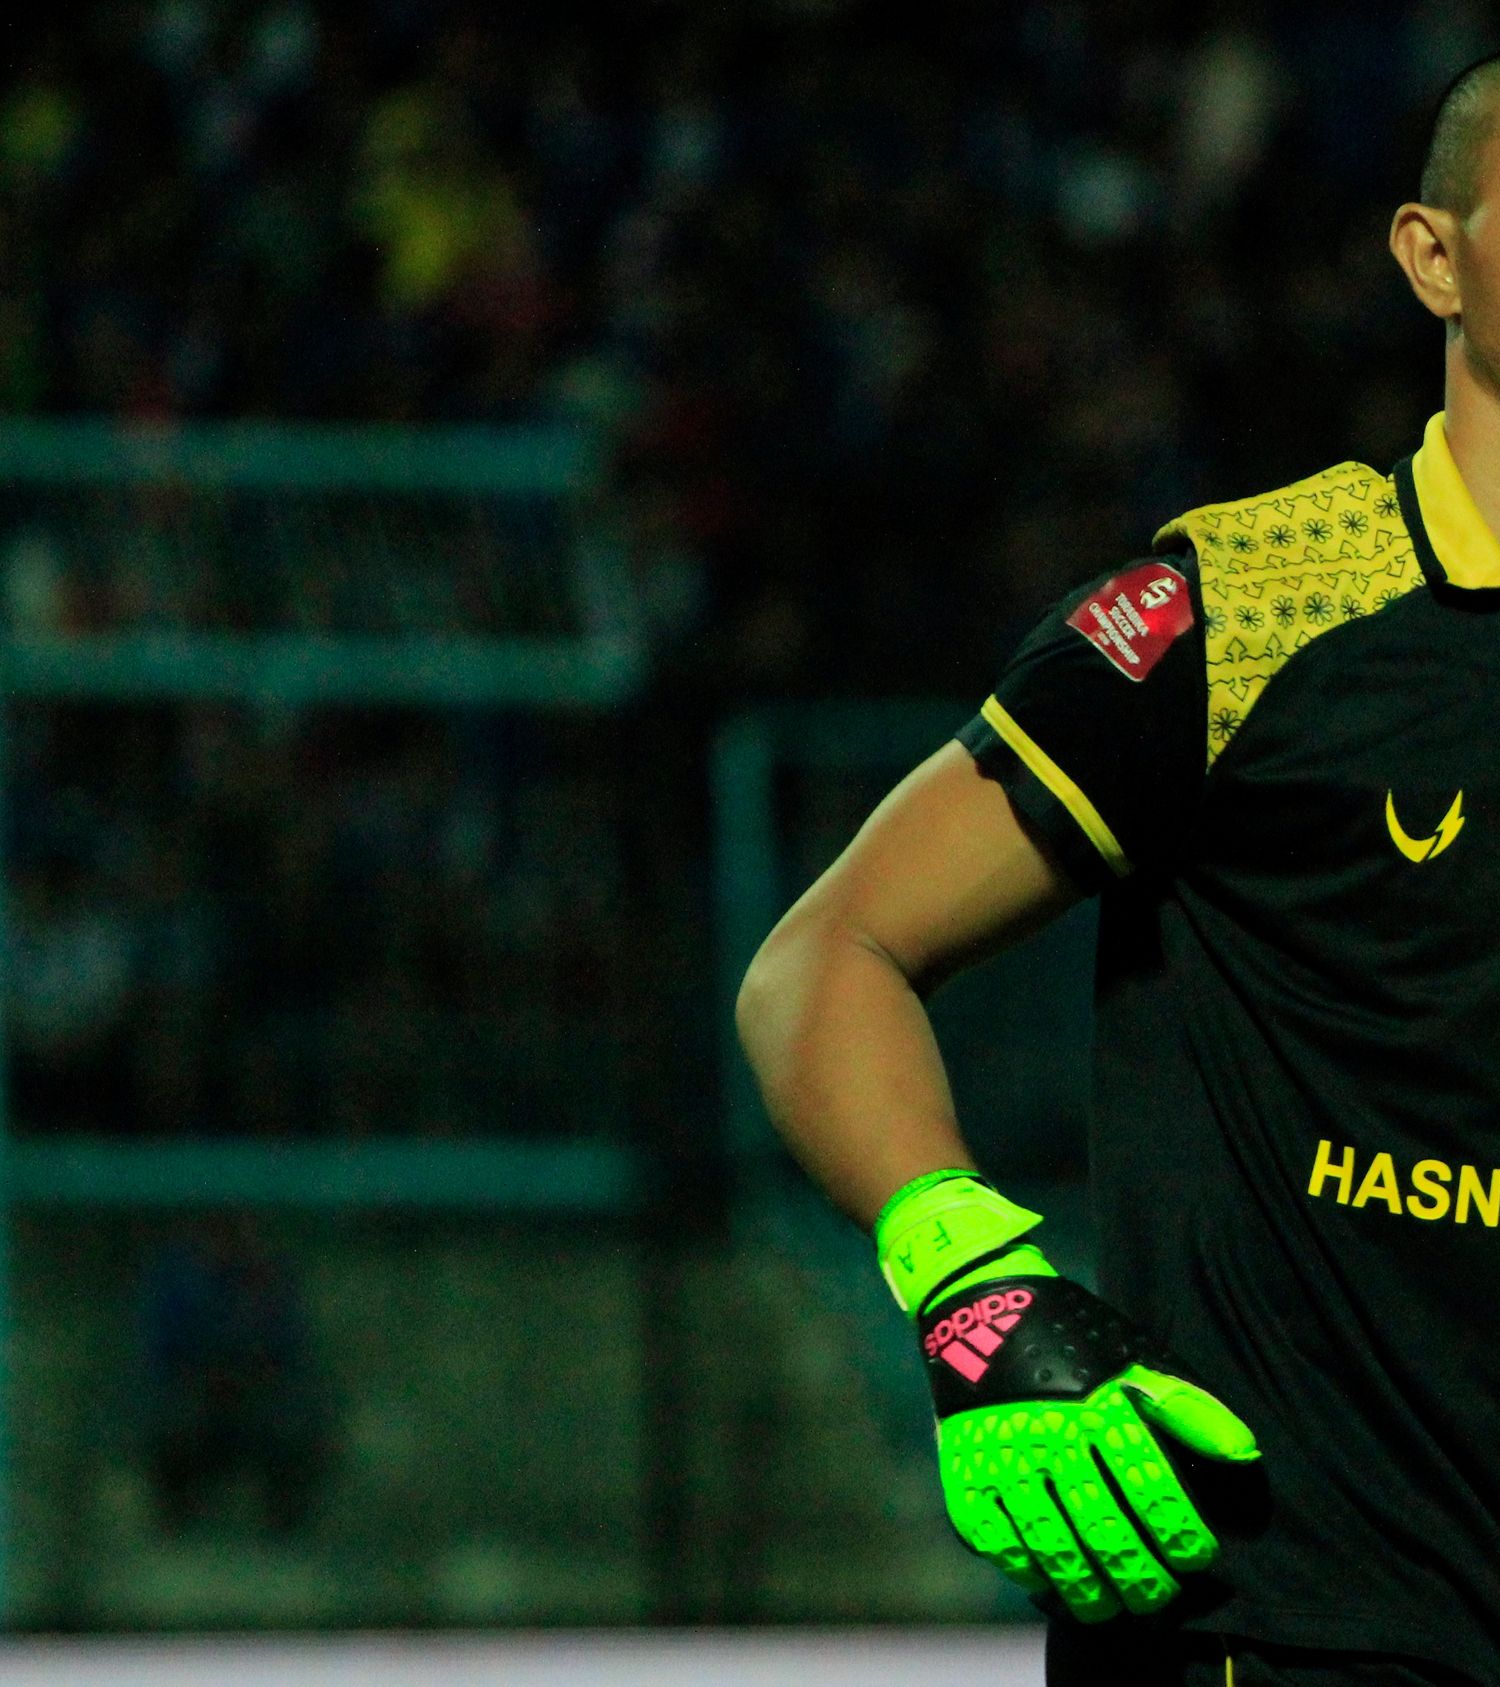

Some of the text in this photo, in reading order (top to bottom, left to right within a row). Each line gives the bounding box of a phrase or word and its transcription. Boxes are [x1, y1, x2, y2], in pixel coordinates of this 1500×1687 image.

[1088, 602, 1140, 665] CHAMPIONSHIP
[1108, 606, 1136, 640] SOCCER
[924, 1289, 1033, 1357] adidas
